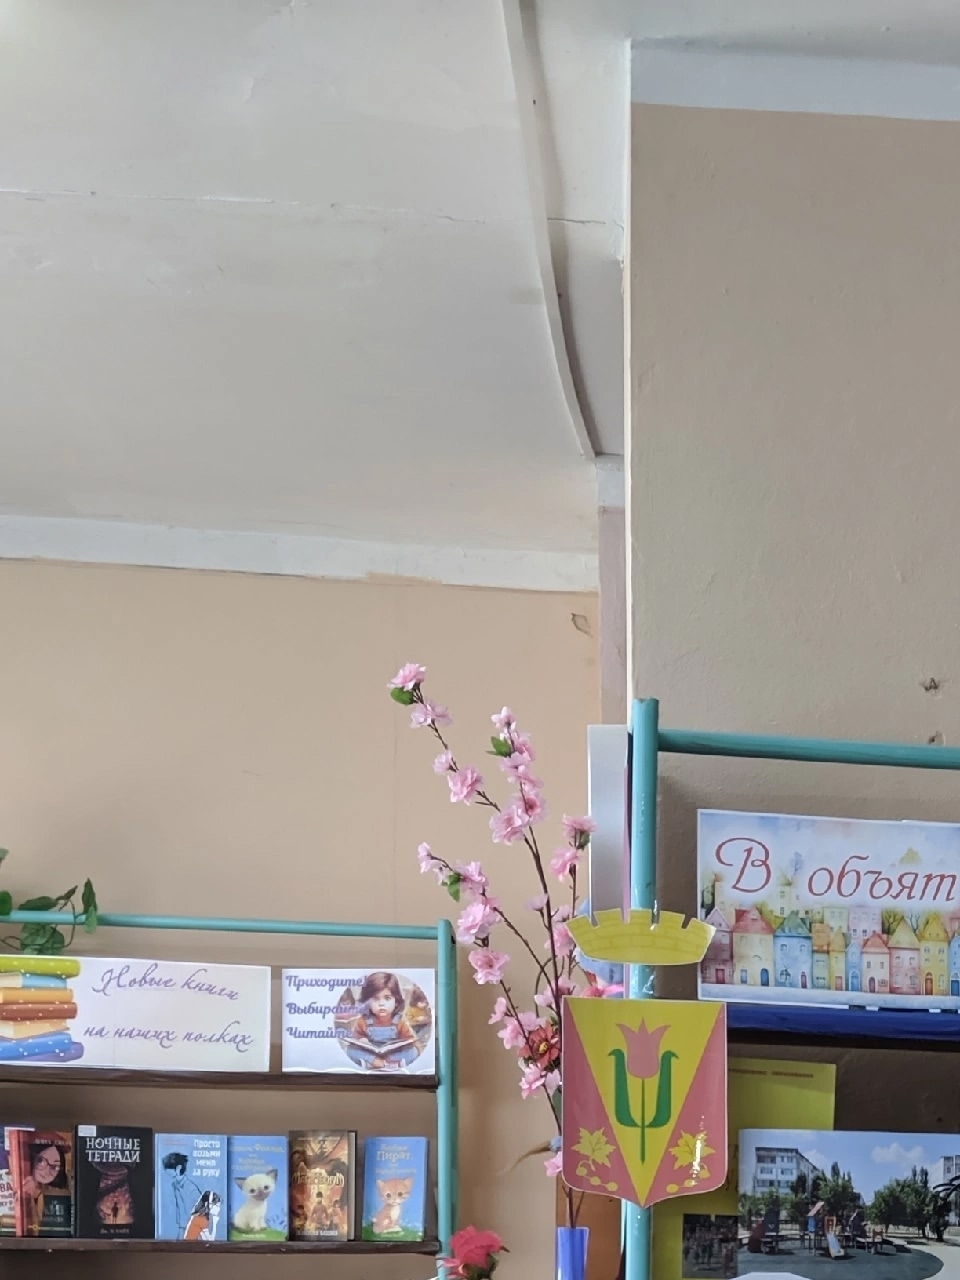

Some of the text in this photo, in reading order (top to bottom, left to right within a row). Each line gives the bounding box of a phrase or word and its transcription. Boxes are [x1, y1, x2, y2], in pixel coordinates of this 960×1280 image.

[714, 837, 773, 894] В
[92, 963, 240, 1001] Новые книги
[83, 1019, 255, 1052] на наших полках
[85, 1150, 141, 1163] ТЕТРАДИ
[86, 1137, 141, 1151] НОЧНЫЕ
